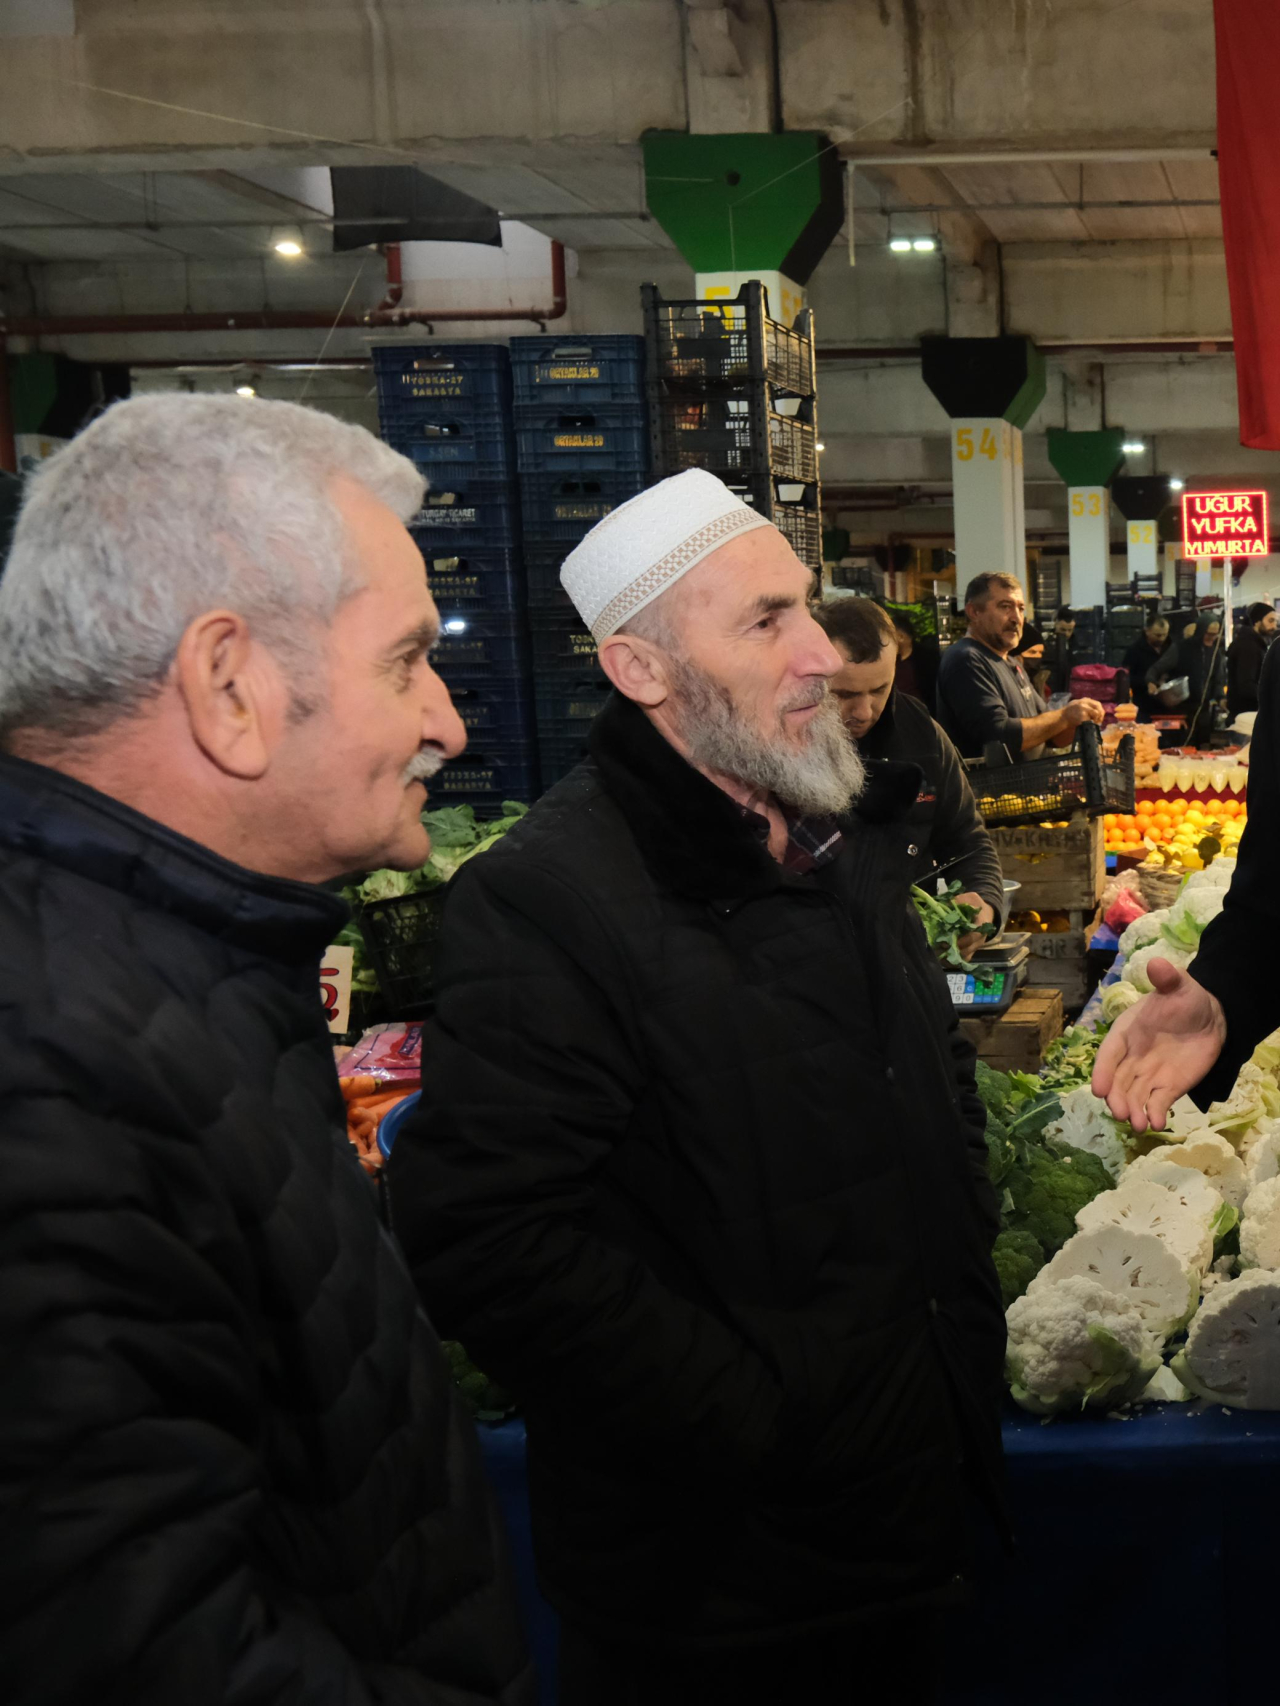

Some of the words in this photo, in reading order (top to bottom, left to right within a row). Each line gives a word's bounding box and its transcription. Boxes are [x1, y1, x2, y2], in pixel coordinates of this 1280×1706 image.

[957, 427, 998, 461] 54
[1072, 493, 1101, 516] 53
[1196, 494, 1252, 513] UĞUR
[1129, 524, 1153, 545] 52
[1191, 516, 1257, 535] YUFKA
[1186, 539, 1265, 555] YUMURTA
